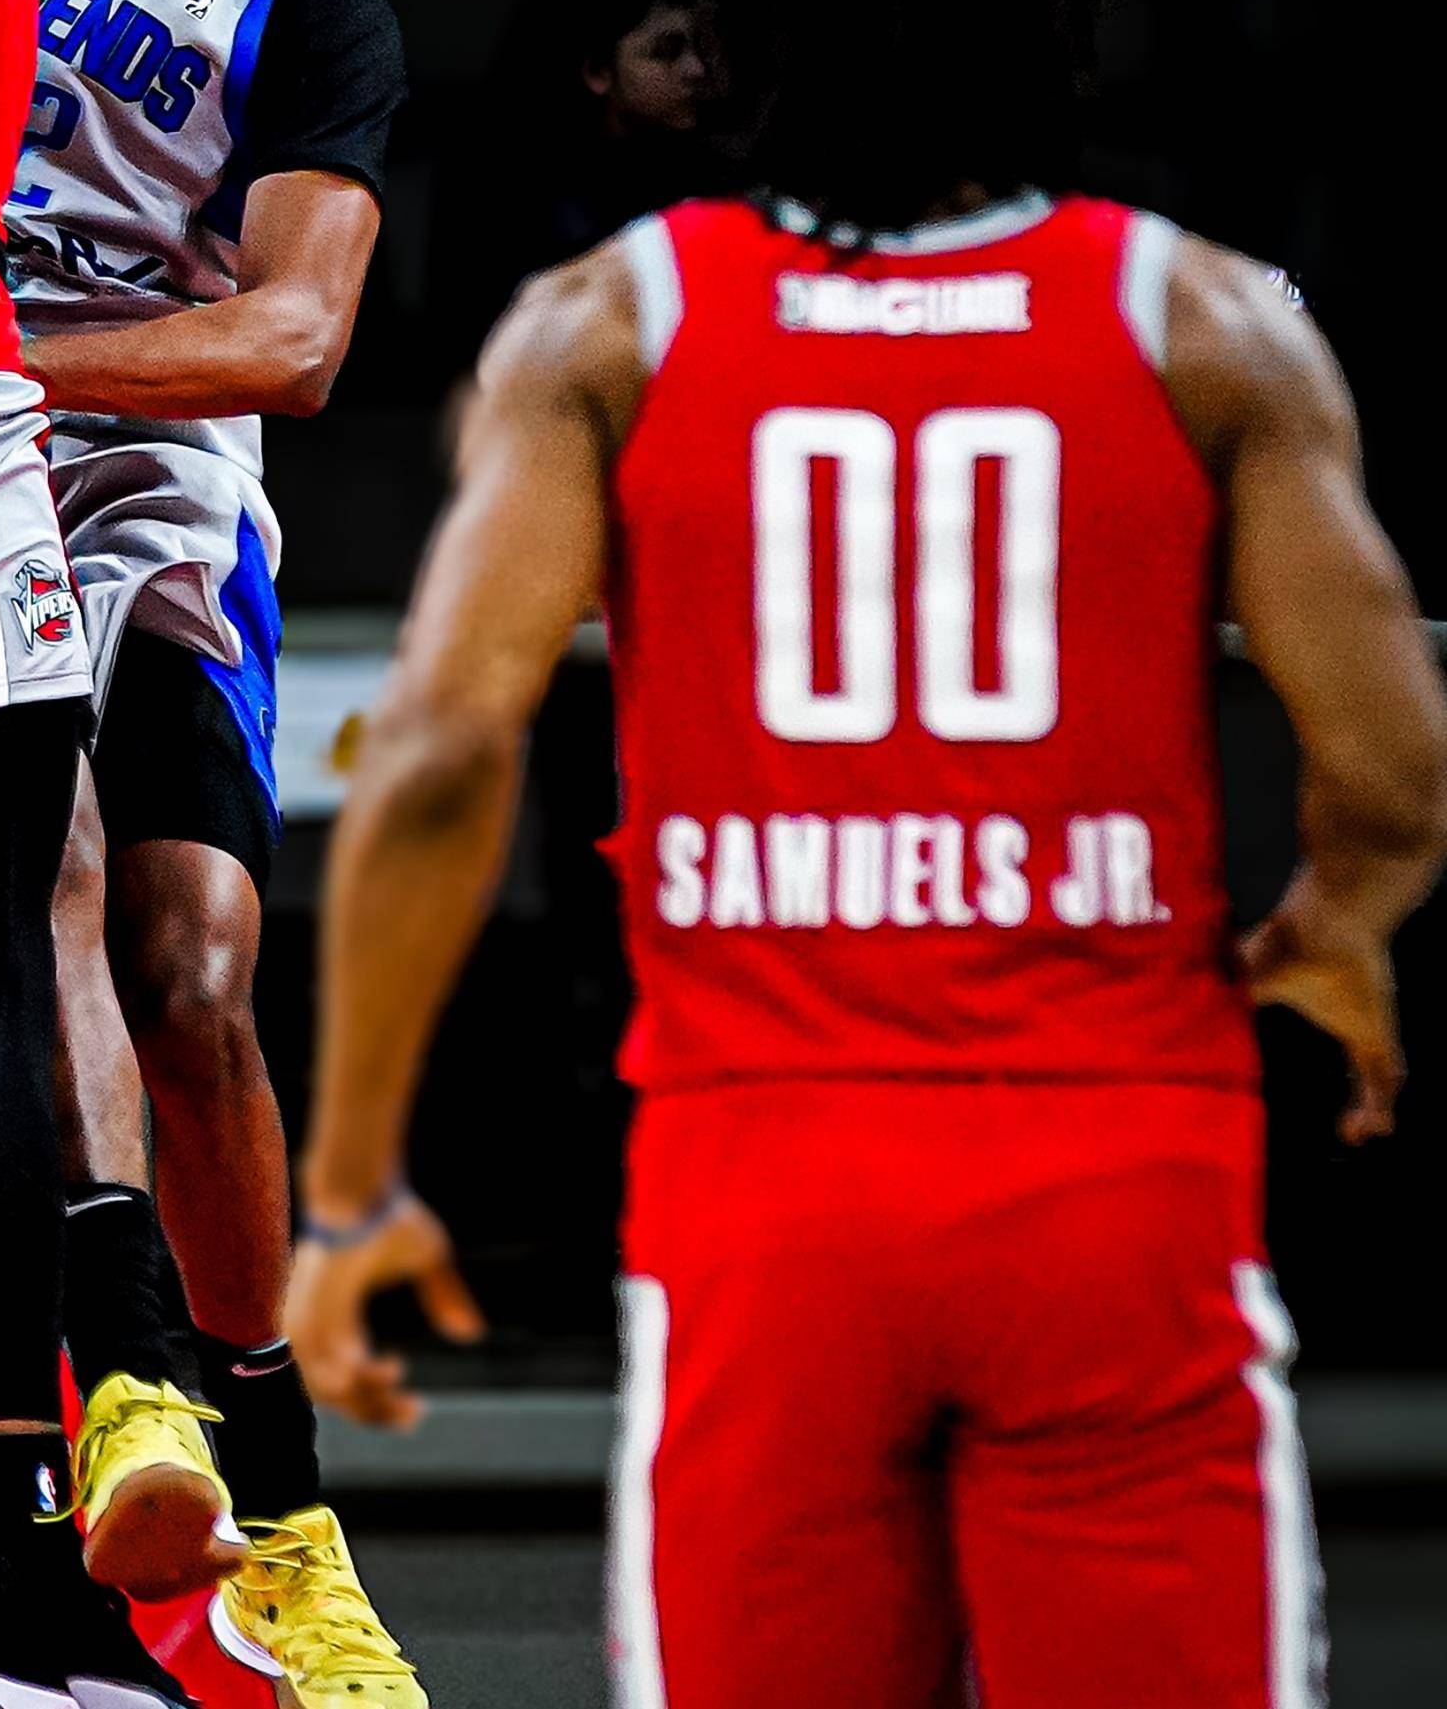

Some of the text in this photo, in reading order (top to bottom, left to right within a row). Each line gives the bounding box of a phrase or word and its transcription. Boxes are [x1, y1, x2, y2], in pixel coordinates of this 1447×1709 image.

[751, 405, 1062, 744] 00
[655, 810, 1173, 929] SAMUELS JR.
